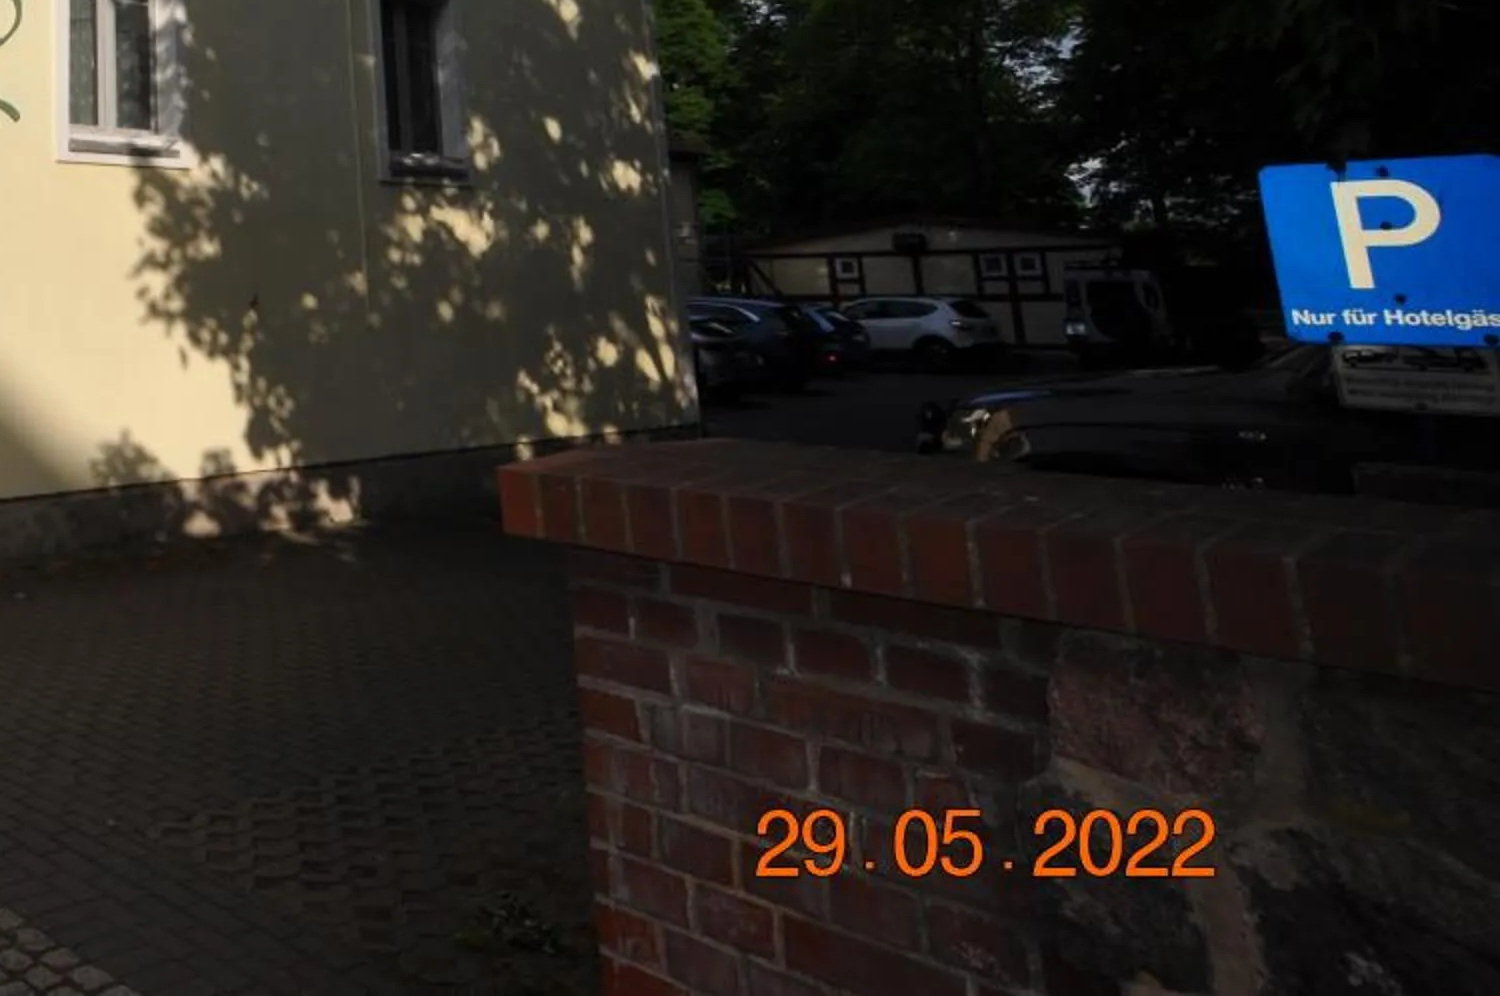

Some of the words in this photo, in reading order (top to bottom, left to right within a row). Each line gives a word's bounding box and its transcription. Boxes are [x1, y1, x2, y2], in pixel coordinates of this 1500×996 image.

[1330, 179, 1441, 289] P
[1291, 308, 1337, 325] Nur
[1342, 308, 1378, 325] für
